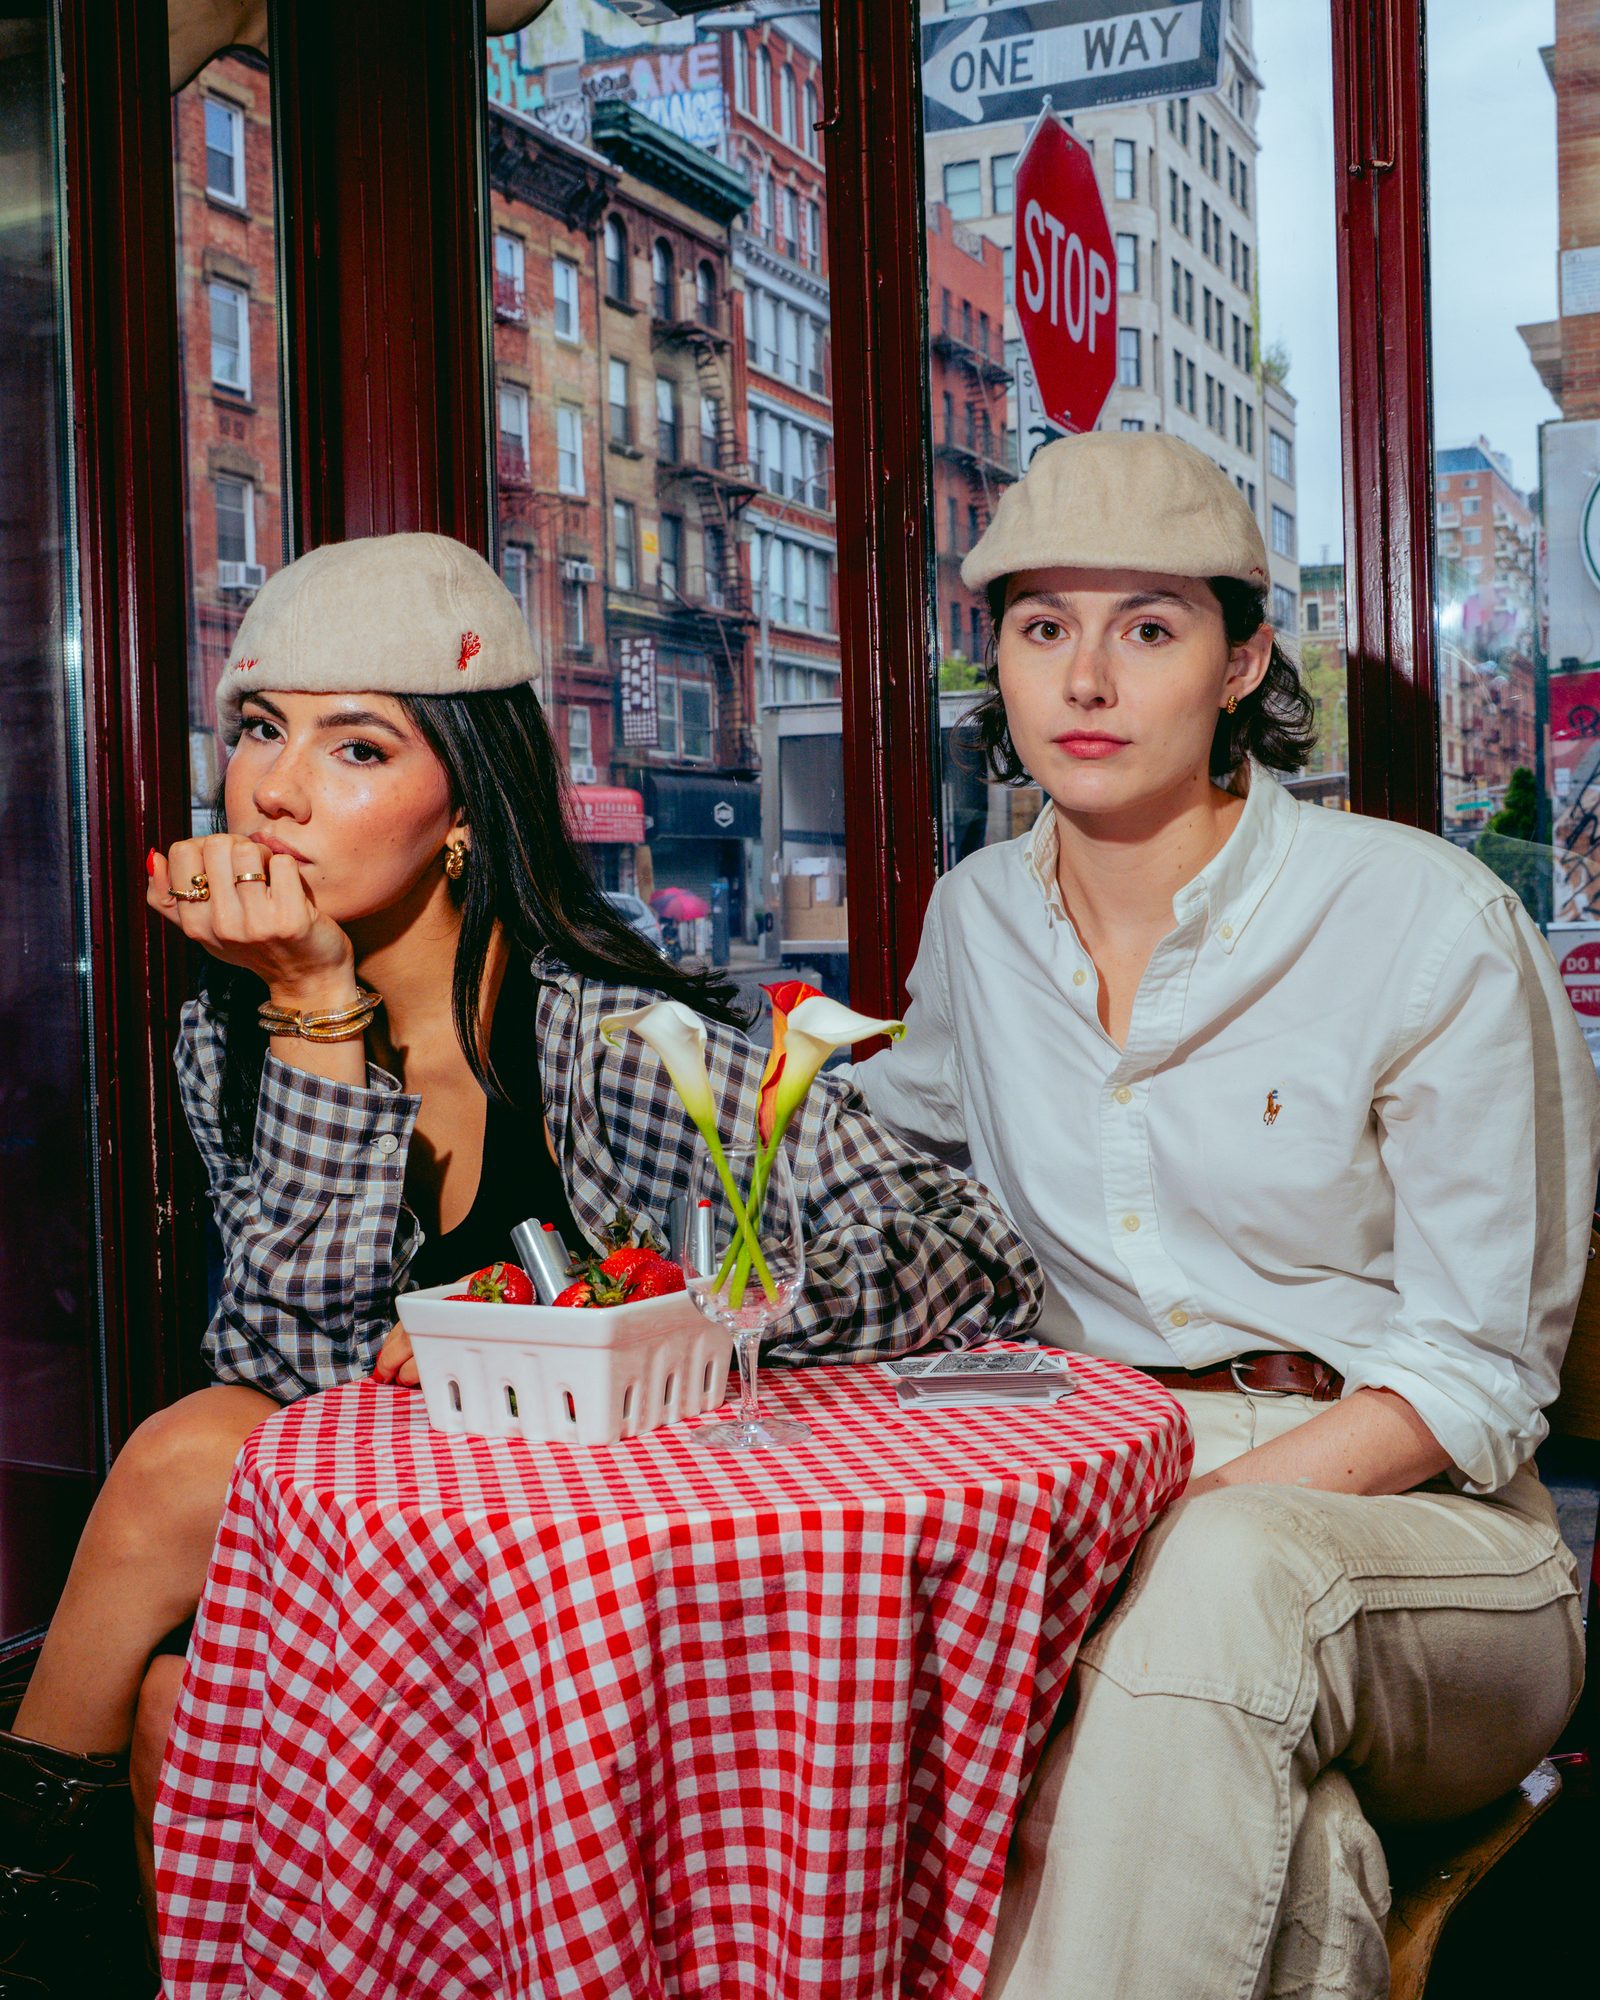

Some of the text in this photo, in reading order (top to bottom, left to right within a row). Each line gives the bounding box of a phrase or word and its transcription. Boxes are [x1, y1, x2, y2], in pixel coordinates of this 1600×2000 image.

[950, 12, 1183, 93] ONE WAY
[1022, 199, 1111, 354] STOP
[1566, 957, 1590, 972] DO
[1570, 987, 1600, 1003] ENT
